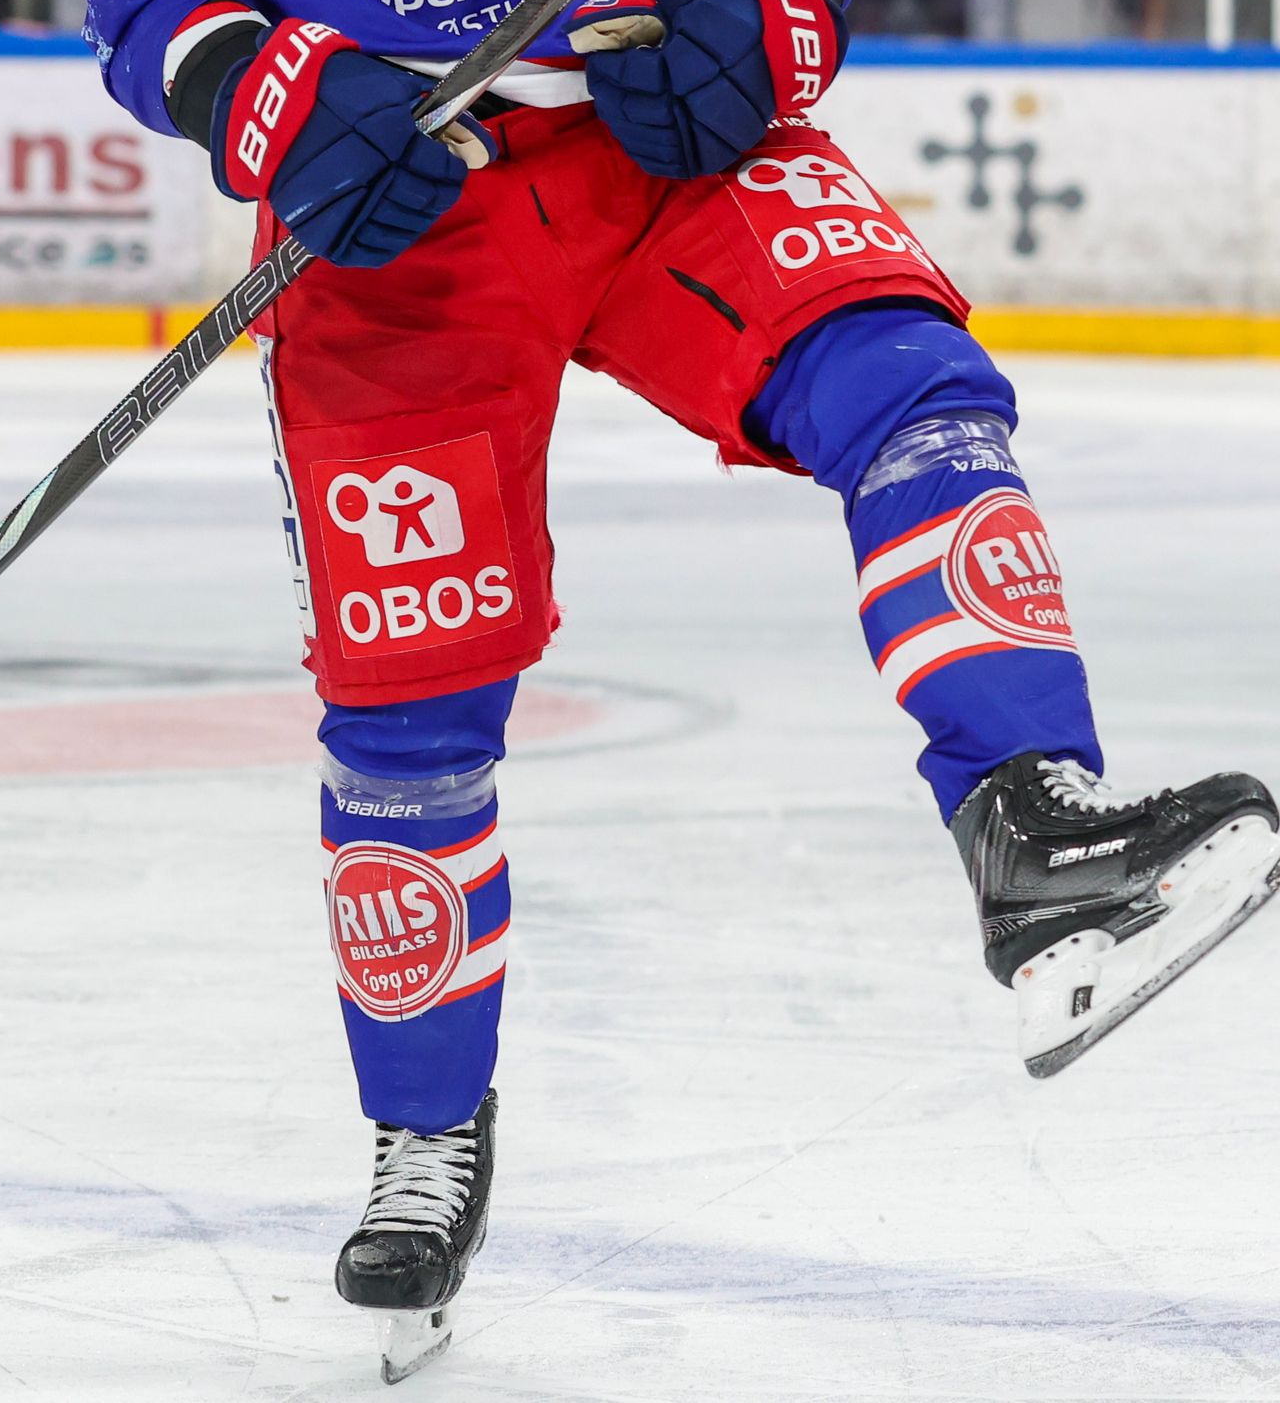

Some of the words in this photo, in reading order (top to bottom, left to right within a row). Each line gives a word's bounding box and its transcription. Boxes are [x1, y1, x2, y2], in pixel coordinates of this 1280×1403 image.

[771, 217, 936, 272] OBOS
[339, 565, 514, 644] OBOS
[335, 880, 439, 942] RIIS
[349, 929, 438, 961] BILGLASS
[405, 963, 430, 984] 09
